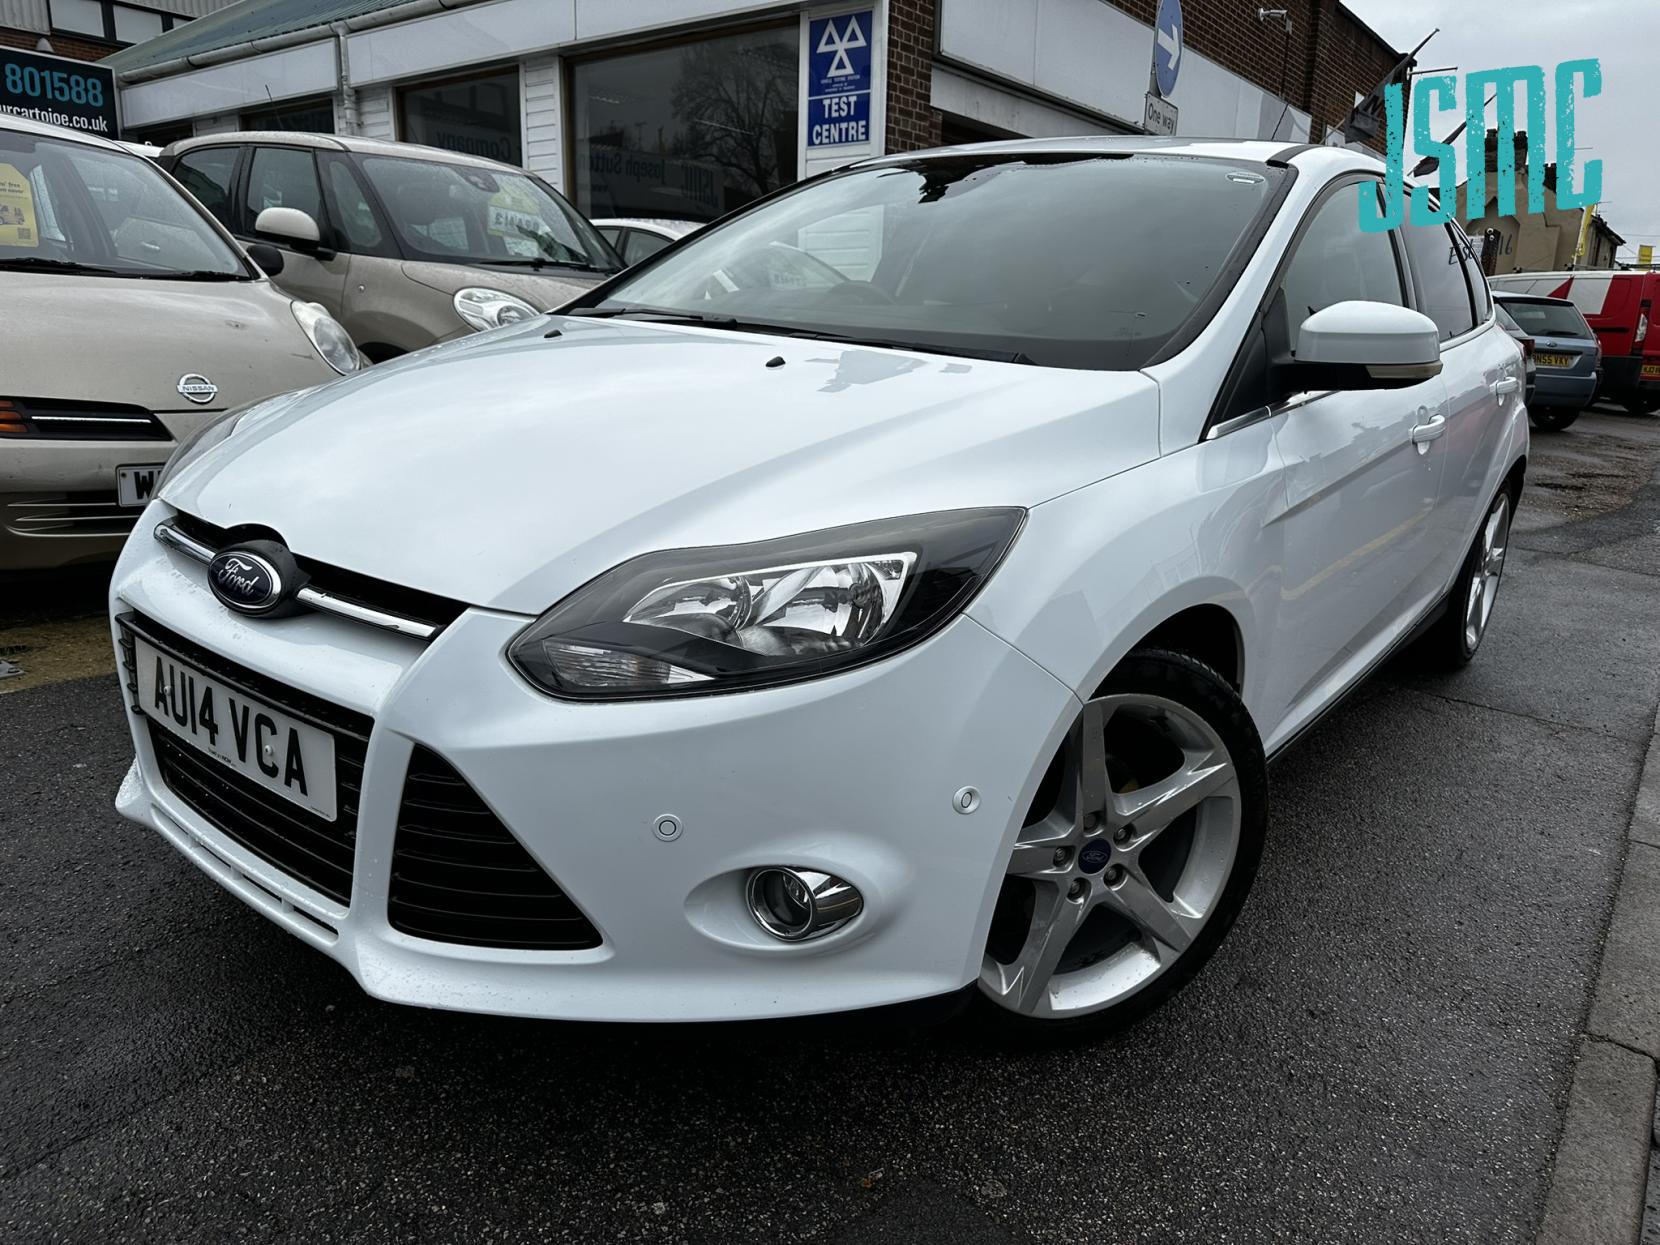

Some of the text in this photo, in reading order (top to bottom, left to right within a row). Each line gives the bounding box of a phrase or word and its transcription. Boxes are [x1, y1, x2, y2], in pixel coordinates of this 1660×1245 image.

[4, 63, 104, 107] 801588
[823, 95, 857, 118] TEST
[1148, 103, 1174, 135] One way
[812, 120, 866, 145] CENTRE
[218, 558, 260, 596] Ford
[154, 655, 308, 797] AU14 VCA
